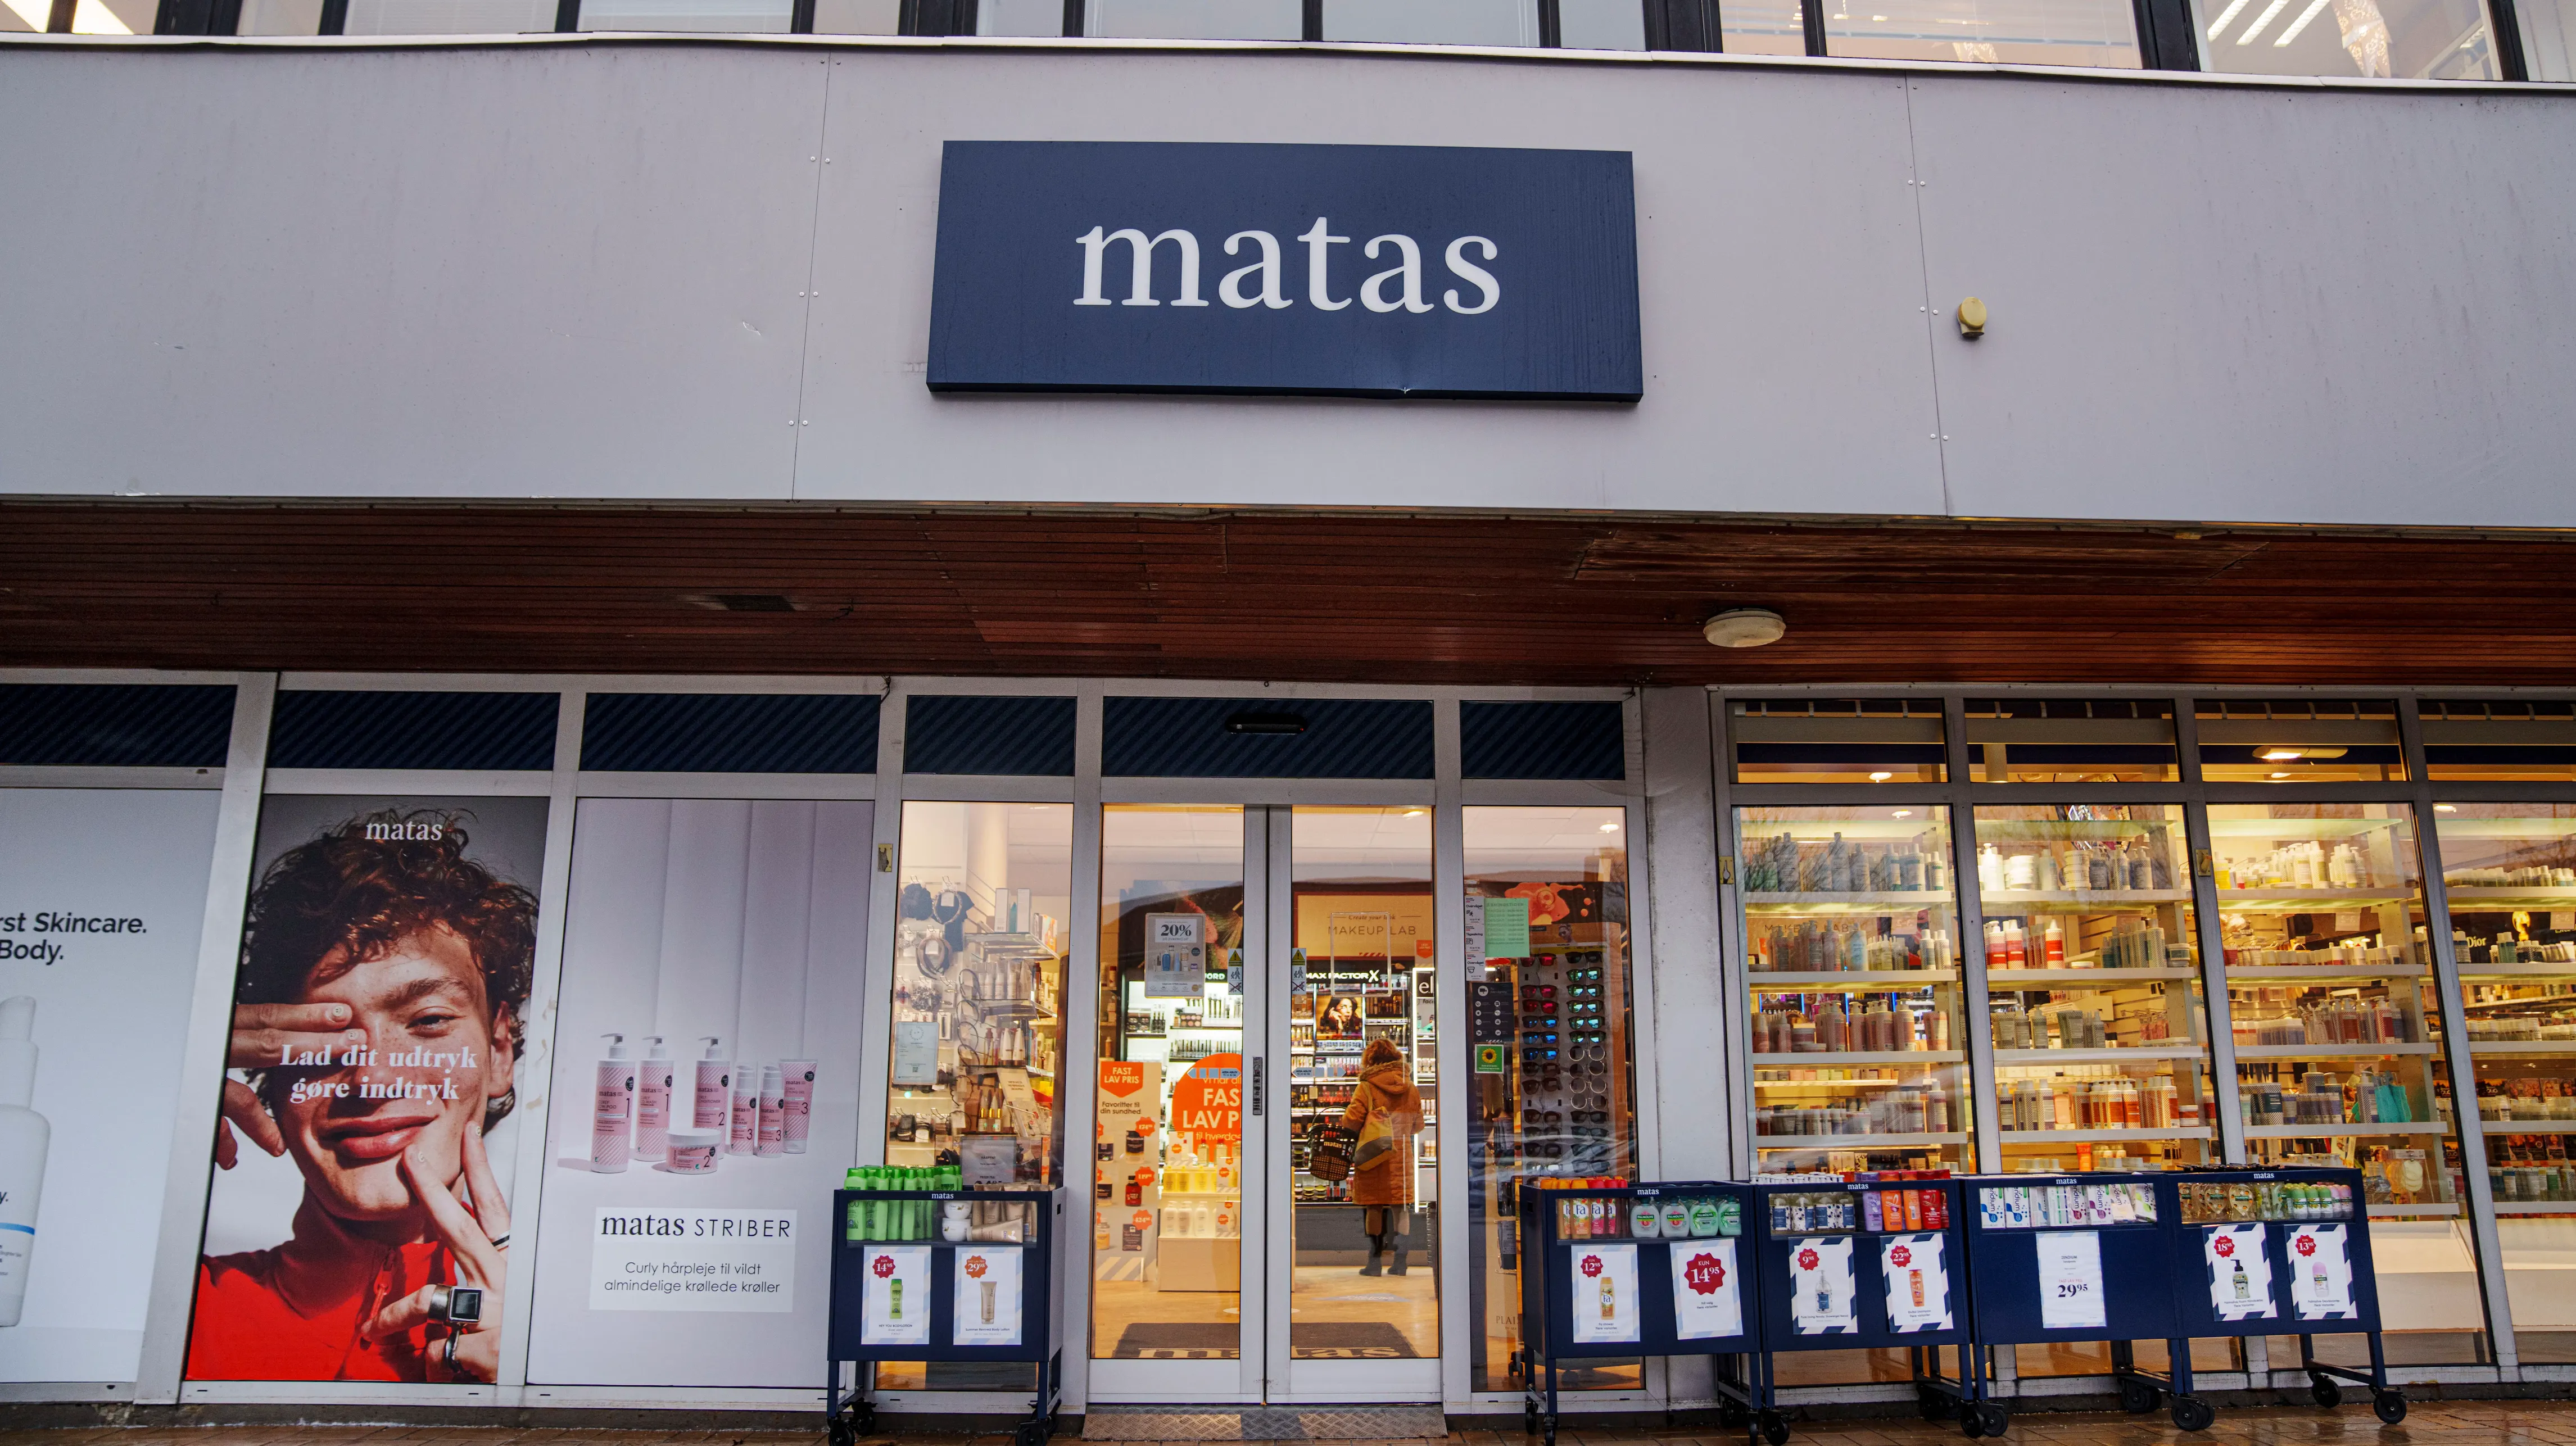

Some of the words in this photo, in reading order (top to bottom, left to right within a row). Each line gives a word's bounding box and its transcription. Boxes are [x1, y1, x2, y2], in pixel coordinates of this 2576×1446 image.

[1073, 217, 1501, 314] matas
[365, 821, 443, 841] matas
[33, 912, 147, 933] Skincare.
[1160, 924, 1192, 937] 20%
[1328, 926, 1384, 935] MAKEUP
[1390, 926, 1416, 935] LAB
[2466, 936, 2487, 948] Dior
[0, 939, 64, 965] Body.
[279, 1044, 331, 1066] Lad
[341, 1044, 378, 1067] dit
[388, 1045, 478, 1074] udtryk
[1104, 1075, 1120, 1084] LAV
[1122, 1076, 1140, 1084] PRIS
[290, 1077, 350, 1104] gøre
[358, 1077, 459, 1105] indtryk
[1203, 1088, 1241, 1107] FAS
[626, 1098, 630, 1118] 1
[665, 1094, 669, 1112] 1
[801, 1102, 808, 1114] 3
[718, 1112, 725, 1126] 2
[1183, 1110, 1221, 1128] LAV
[746, 1128, 753, 1140] 3
[776, 1130, 781, 1141] 3
[704, 1155, 710, 1167] 2
[1576, 1205, 1586, 1214] Fa
[1592, 1204, 1601, 1214] Fa
[1608, 1205, 1613, 1214] a
[601, 1214, 685, 1236] matas
[694, 1218, 790, 1238] STRIBER
[625, 1262, 658, 1276] Curly
[662, 1262, 716, 1276] hårpleje
[720, 1263, 730, 1275] til
[734, 1263, 762, 1275] vildt
[604, 1280, 681, 1294] almindelige
[685, 1281, 737, 1292] krøllede
[741, 1281, 780, 1293] krøller
